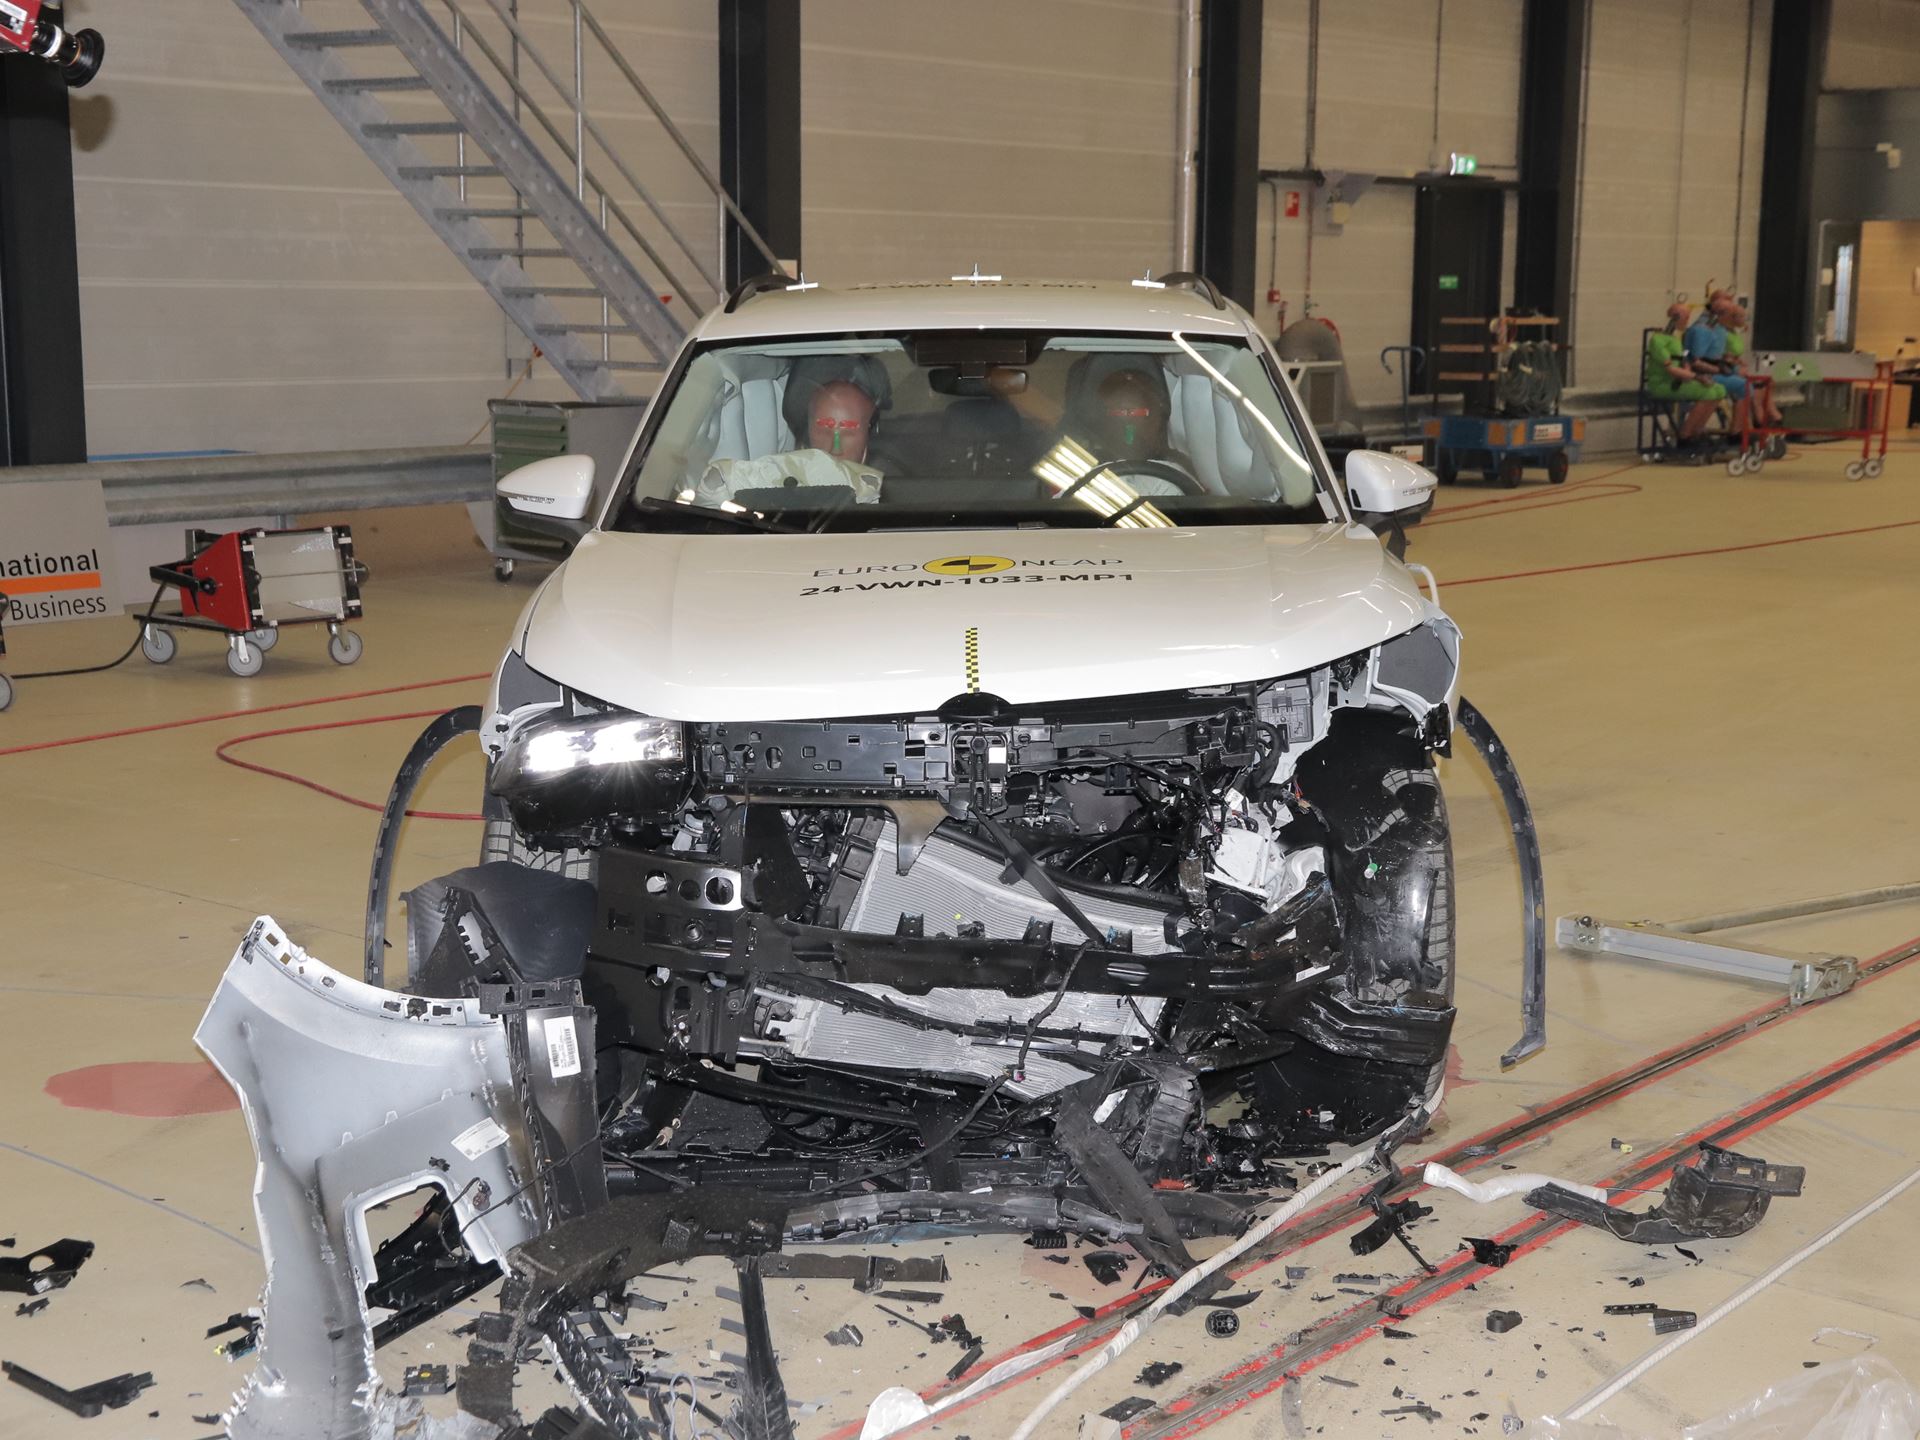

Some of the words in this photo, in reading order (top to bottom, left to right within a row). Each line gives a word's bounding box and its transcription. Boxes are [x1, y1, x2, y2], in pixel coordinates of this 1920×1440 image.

[813, 564, 918, 578] EURO
[1020, 558, 1124, 567] NCAP
[799, 573, 1133, 596] 24-VWN-1033-MP1
[10, 594, 107, 621] Business
